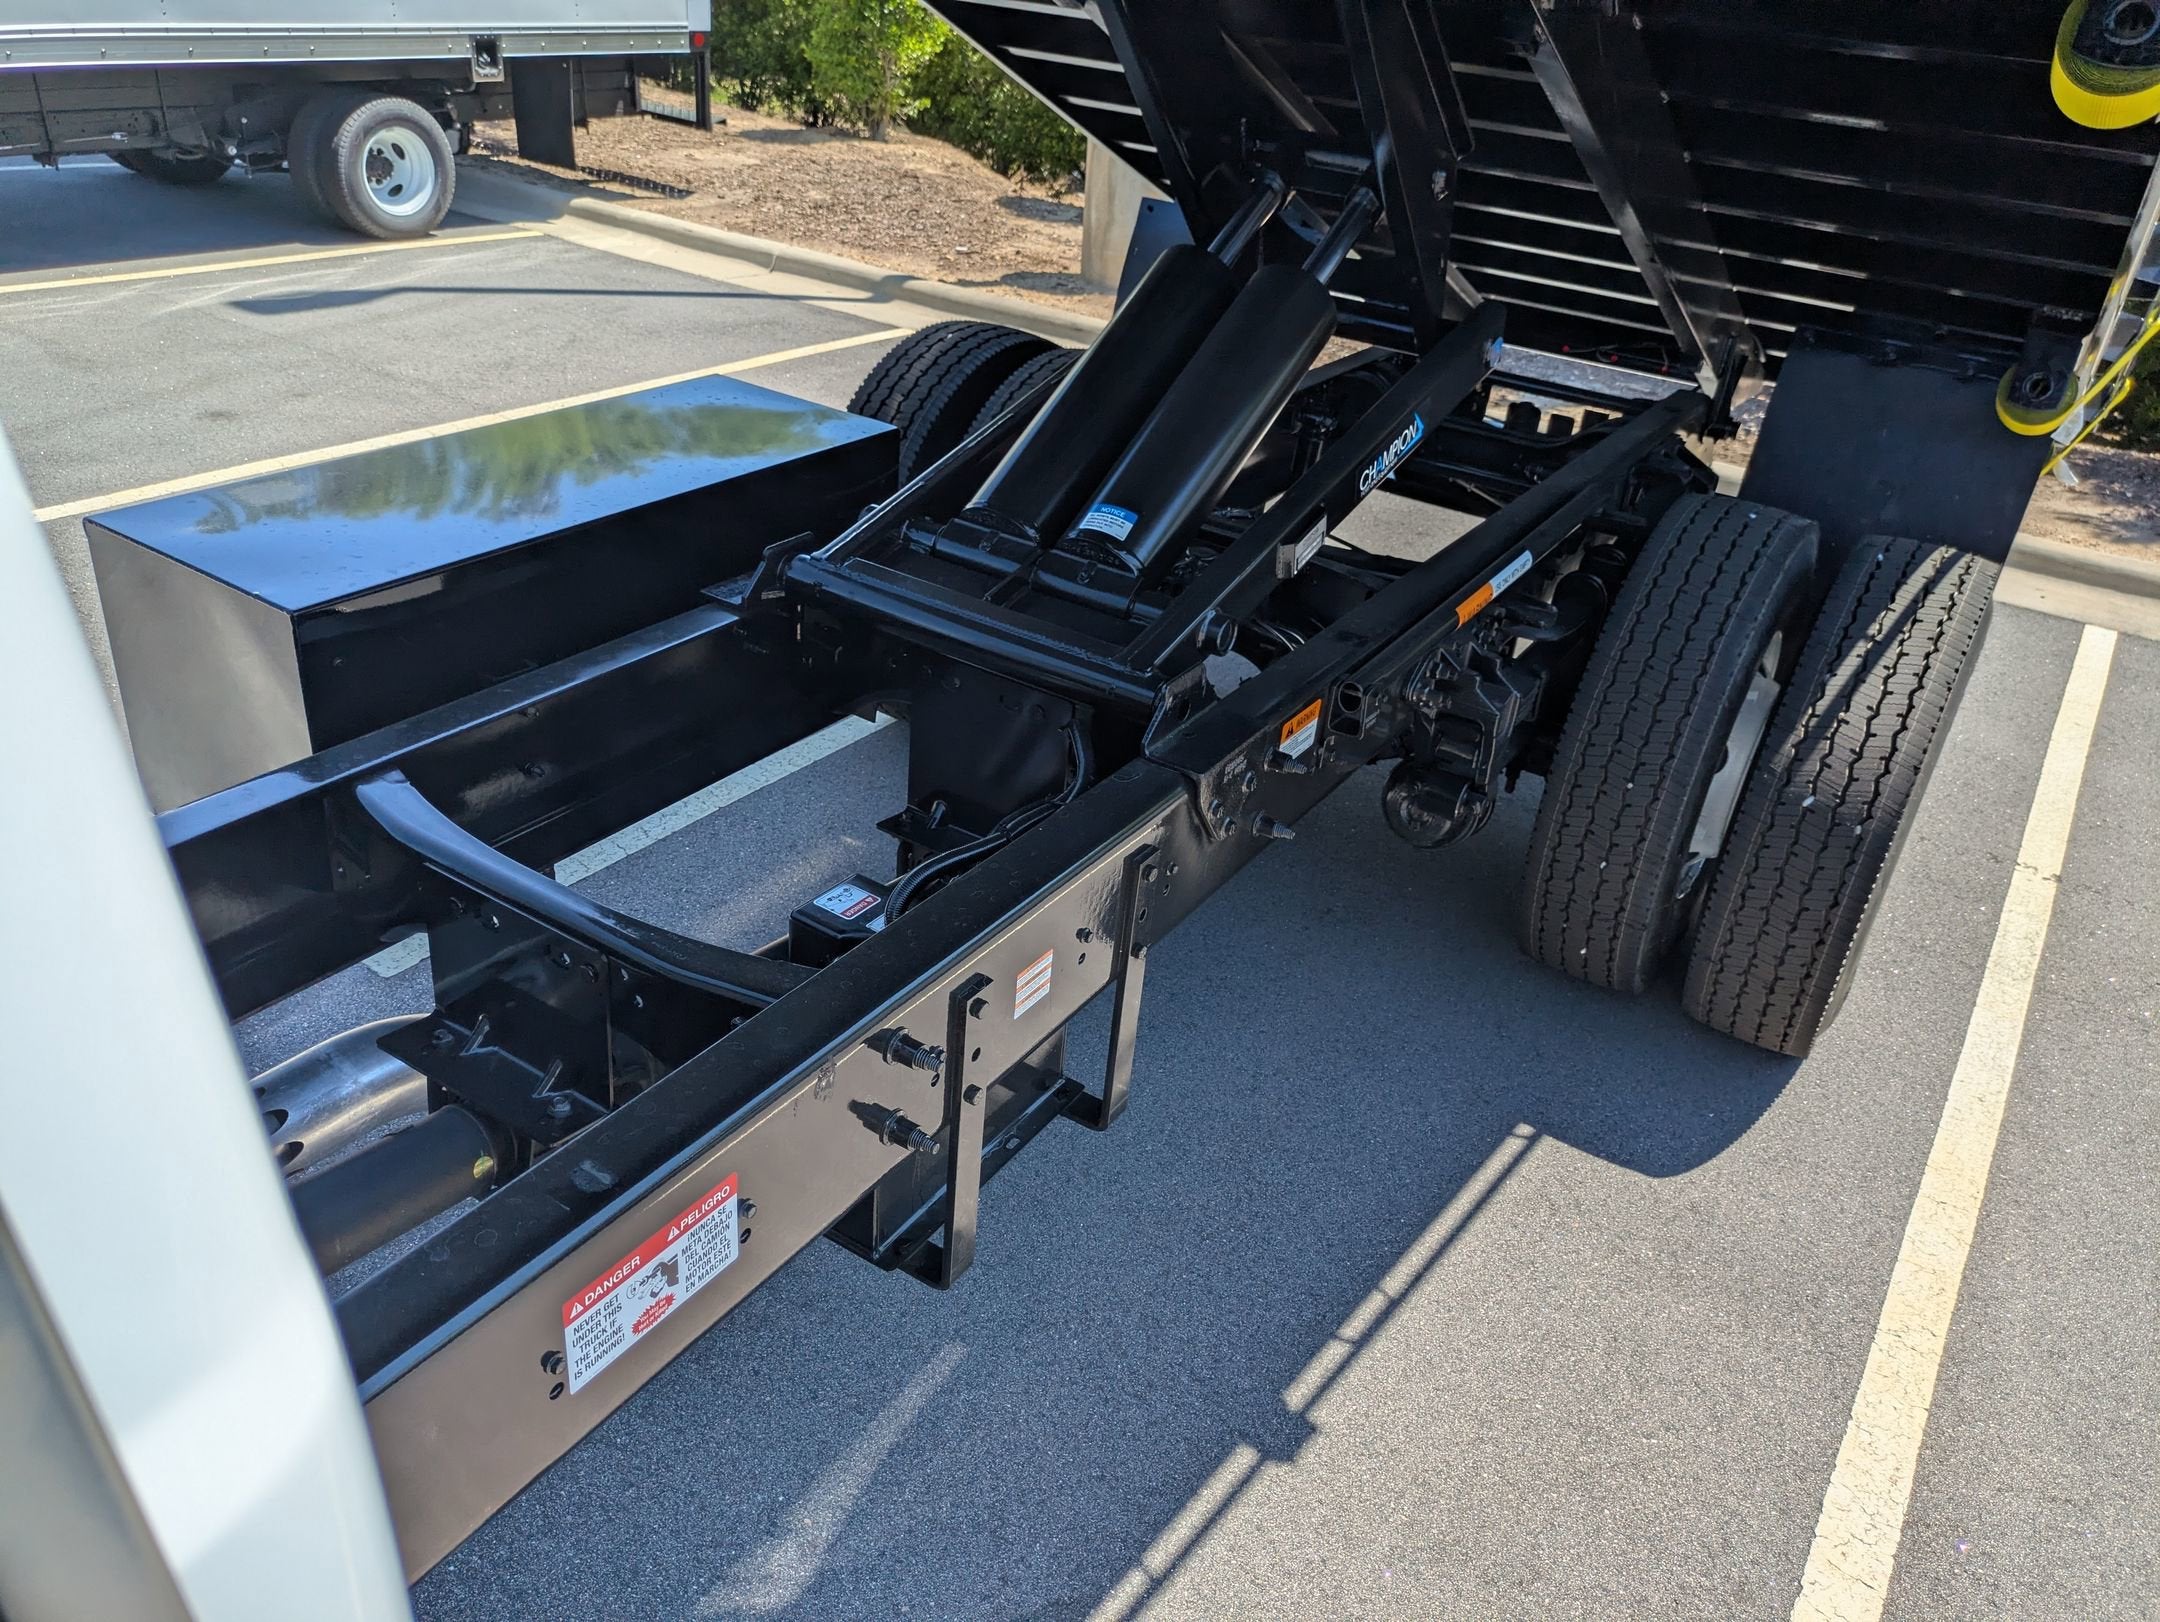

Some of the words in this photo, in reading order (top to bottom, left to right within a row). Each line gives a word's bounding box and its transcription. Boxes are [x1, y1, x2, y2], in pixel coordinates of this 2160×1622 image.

[1360, 420, 1417, 490] CHAMPION
[1101, 507, 1126, 517] NOTICE
[680, 1185, 730, 1231] PELIGRO
[717, 1204, 727, 1218] SE
[681, 1238, 701, 1257] META
[704, 1210, 733, 1239] DEBAJO
[685, 1250, 699, 1264] DEL
[701, 1221, 730, 1249] CAMIÓN
[687, 1242, 718, 1272] CUANDO
[720, 1235, 728, 1245] EL
[585, 1255, 641, 1305] DANGER
[685, 1257, 712, 1283] MOTOR
[713, 1240, 732, 1258] ESTÉ
[685, 1281, 696, 1293] EN
[697, 1250, 732, 1281] MARCHA!
[572, 1320, 602, 1348] UNDER
[603, 1303, 623, 1322] THIS
[573, 1308, 602, 1336] NEVER
[603, 1293, 620, 1312] GET
[579, 1325, 608, 1353] TRUCK
[609, 1317, 618, 1330] IF
[574, 1349, 592, 1368] THE
[593, 1323, 624, 1353] ENGINE
[574, 1369, 583, 1381] IS
[585, 1333, 625, 1372] RUNNING!
